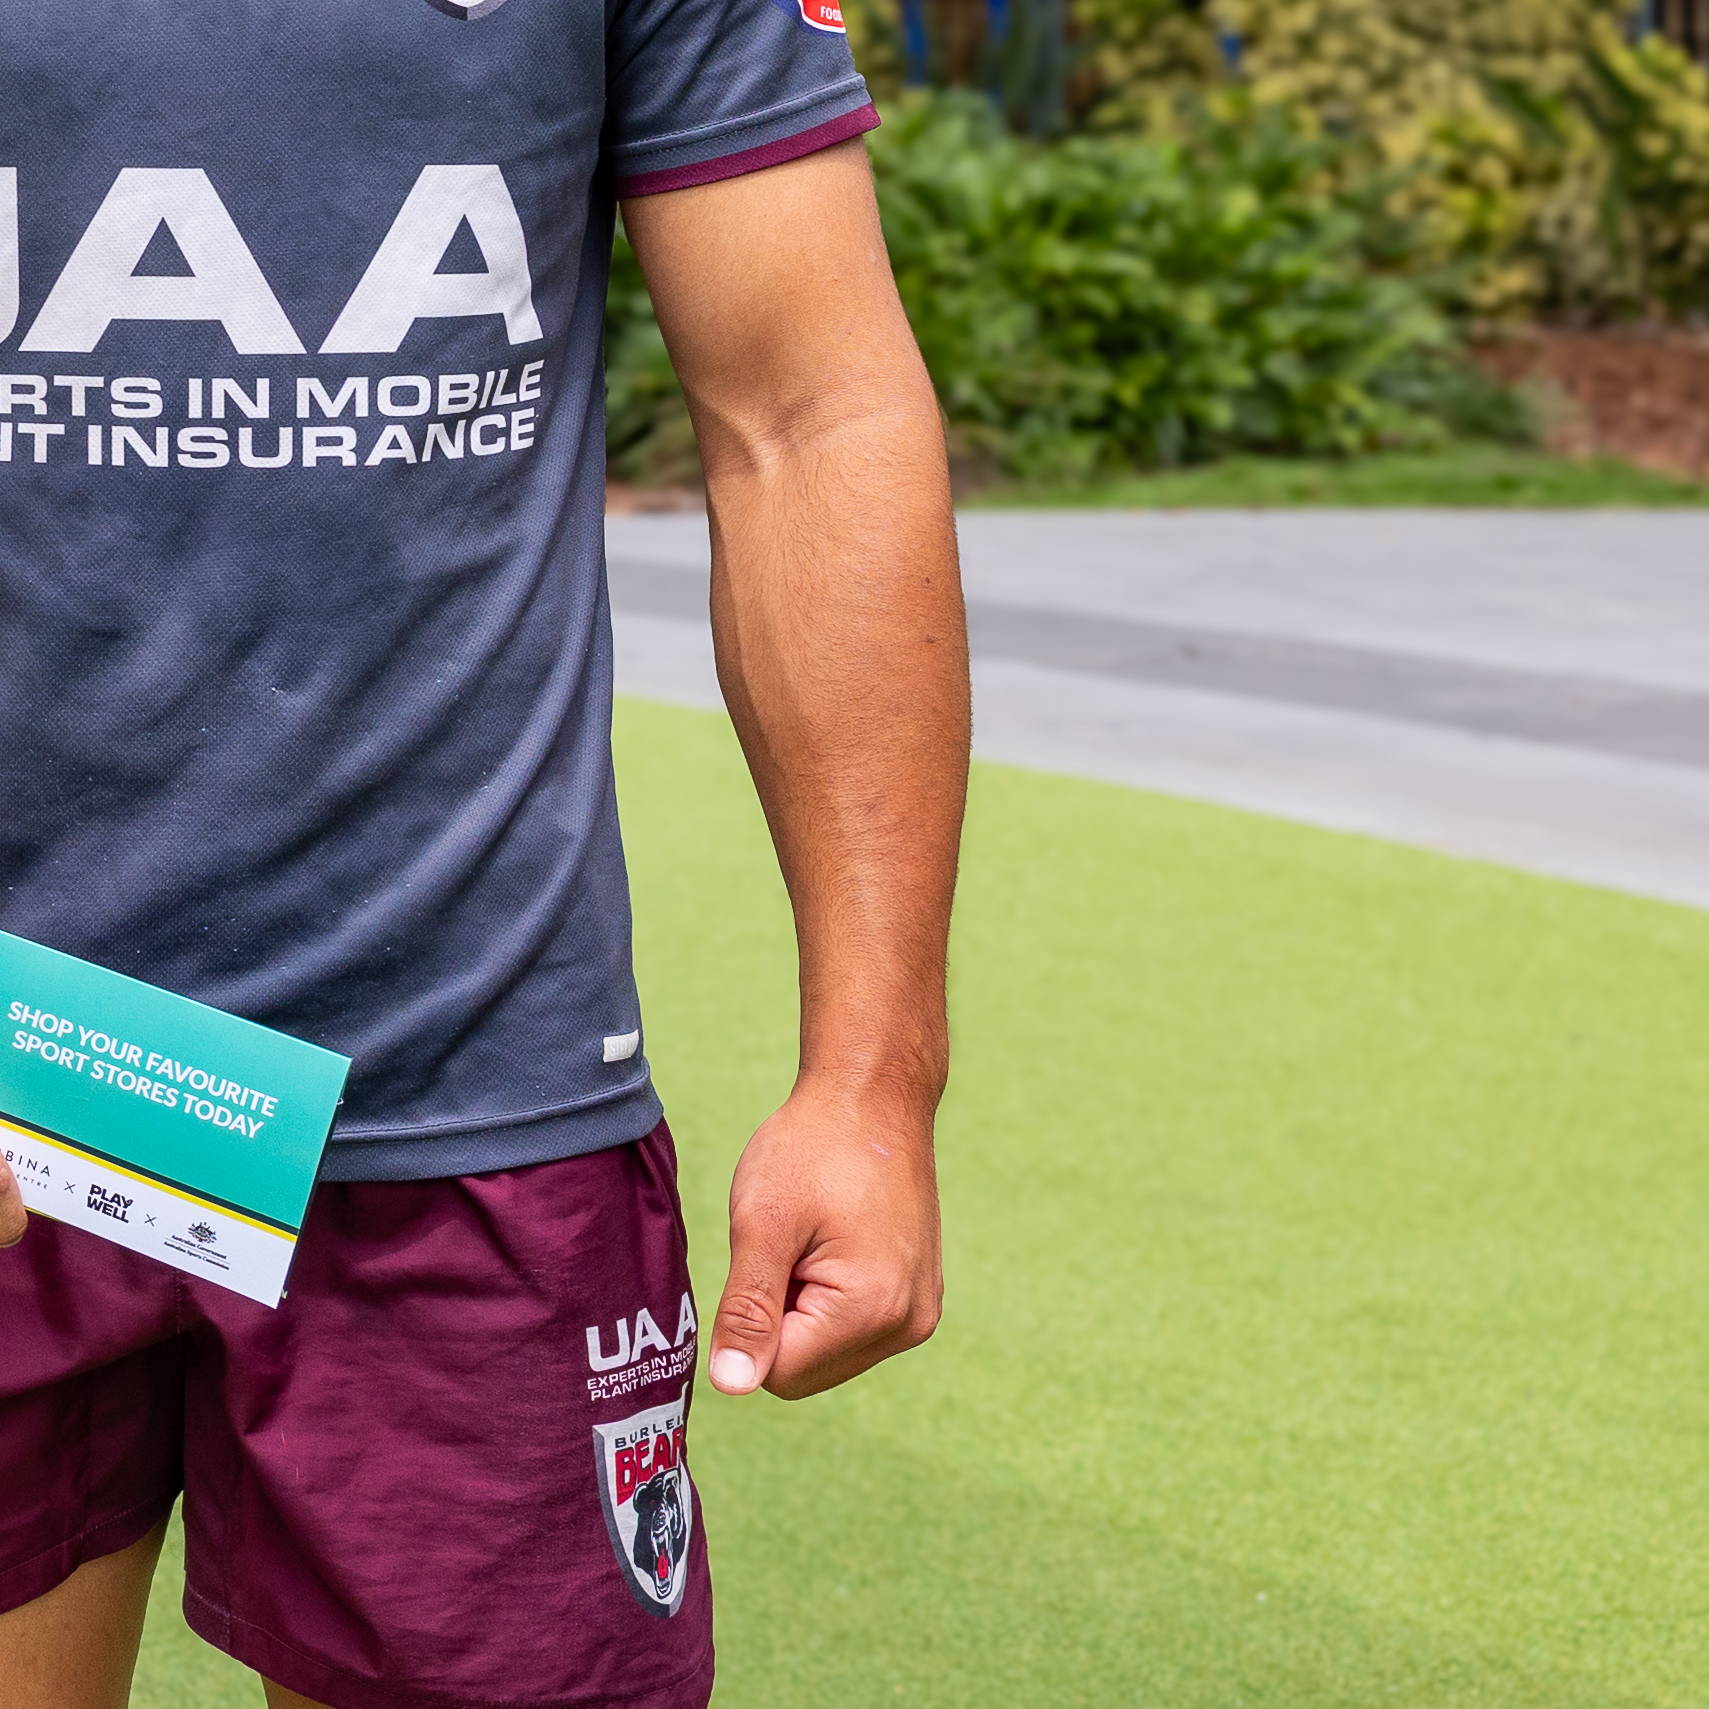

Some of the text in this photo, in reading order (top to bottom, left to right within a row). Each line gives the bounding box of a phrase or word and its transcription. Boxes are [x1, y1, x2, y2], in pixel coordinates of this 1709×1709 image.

[188, 377, 270, 419] IN
[296, 359, 545, 418] MOBILE
[87, 407, 540, 469] INSURANCE
[7, 1001, 279, 1118] SHOP YOUR FAVOURITE
[12, 1030, 265, 1139] SPORT STORES TODAY
[86, 1196, 130, 1224] WELL
[89, 1183, 134, 1209] PLAY
[586, 1291, 696, 1372] UAA
[587, 1361, 650, 1390] EXPERTS
[651, 1355, 666, 1370] IN
[591, 1378, 639, 1402] PLANT
[615, 1415, 683, 1449] BURLEI
